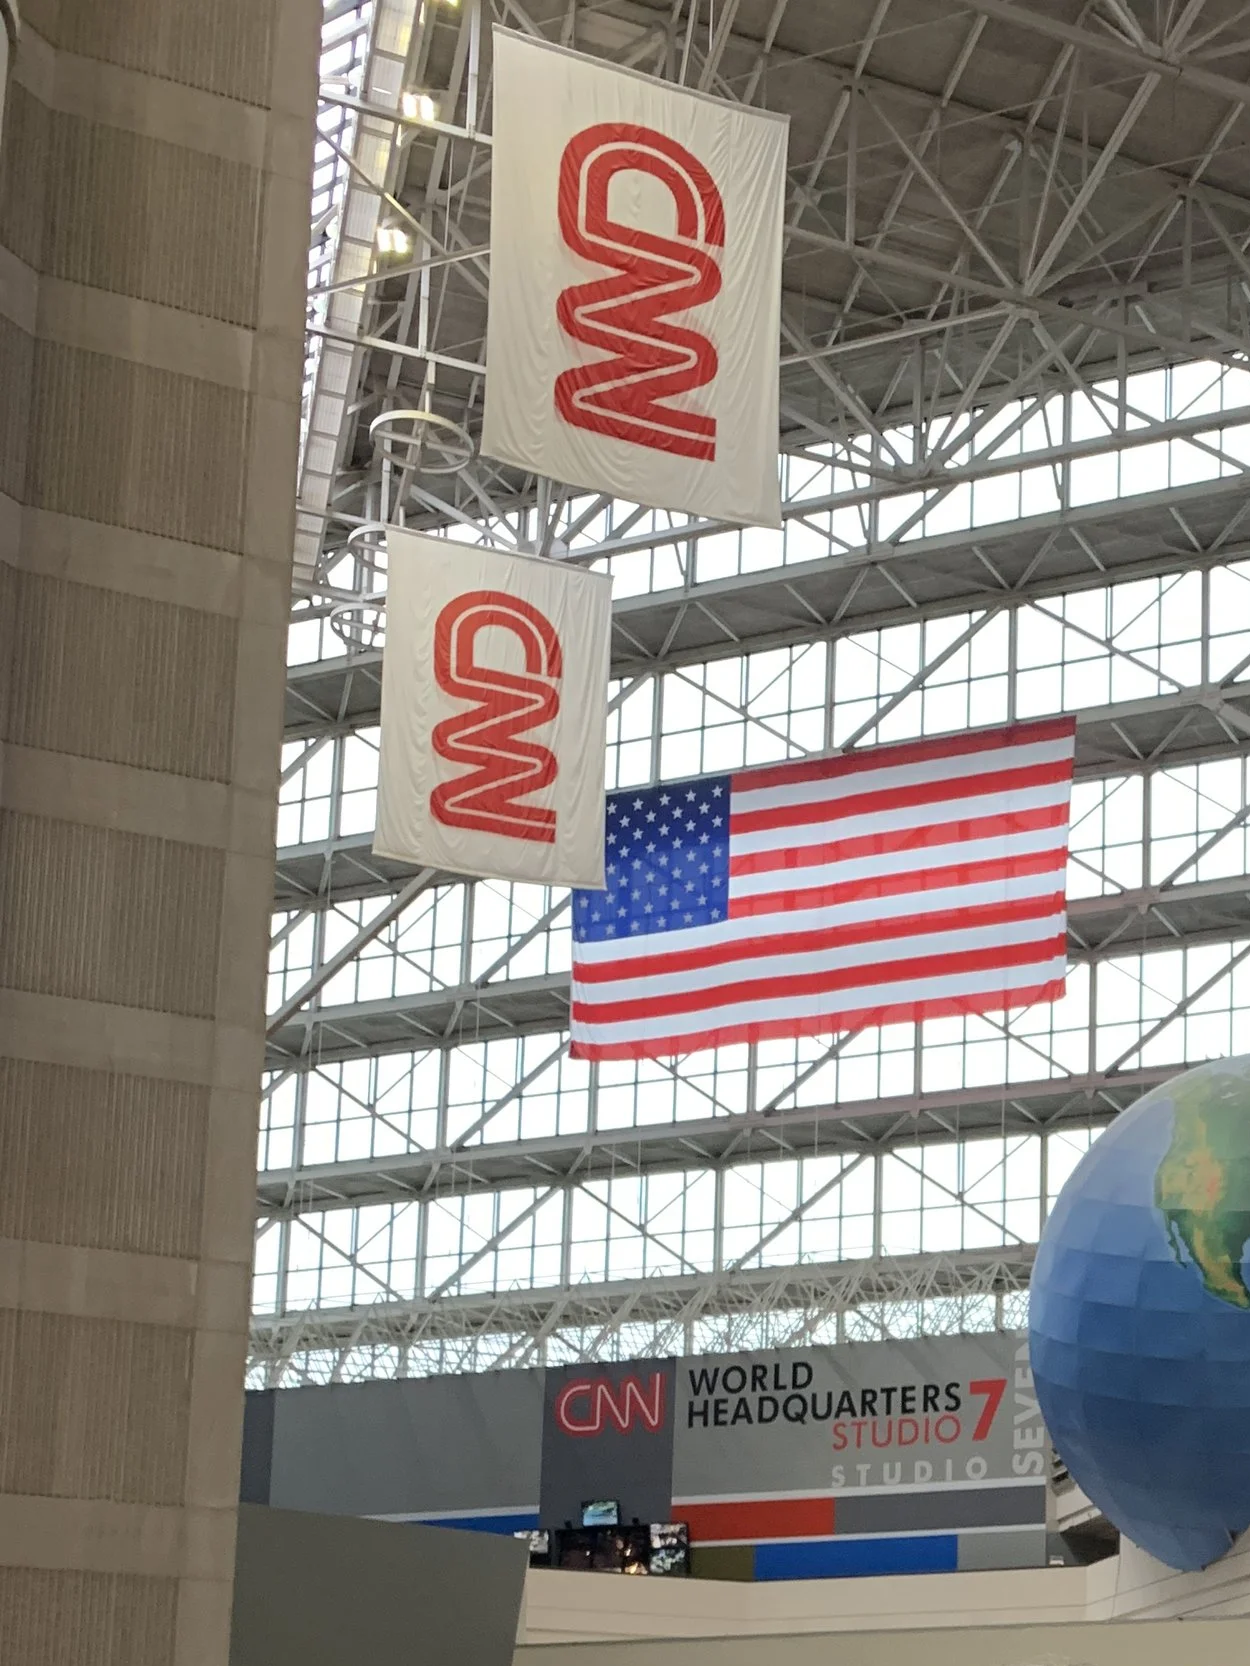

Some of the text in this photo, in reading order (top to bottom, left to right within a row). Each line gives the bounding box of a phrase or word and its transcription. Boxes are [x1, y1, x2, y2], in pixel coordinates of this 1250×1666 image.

[554, 122, 726, 462] CNN
[429, 590, 562, 843] CNN
[555, 1372, 667, 1437] CNN
[688, 1361, 813, 1396] WORLD
[688, 1382, 961, 1428] HEADQUARTERS
[832, 1378, 1007, 1450] STUDIO 7
[831, 1455, 987, 1487] STUDIO
